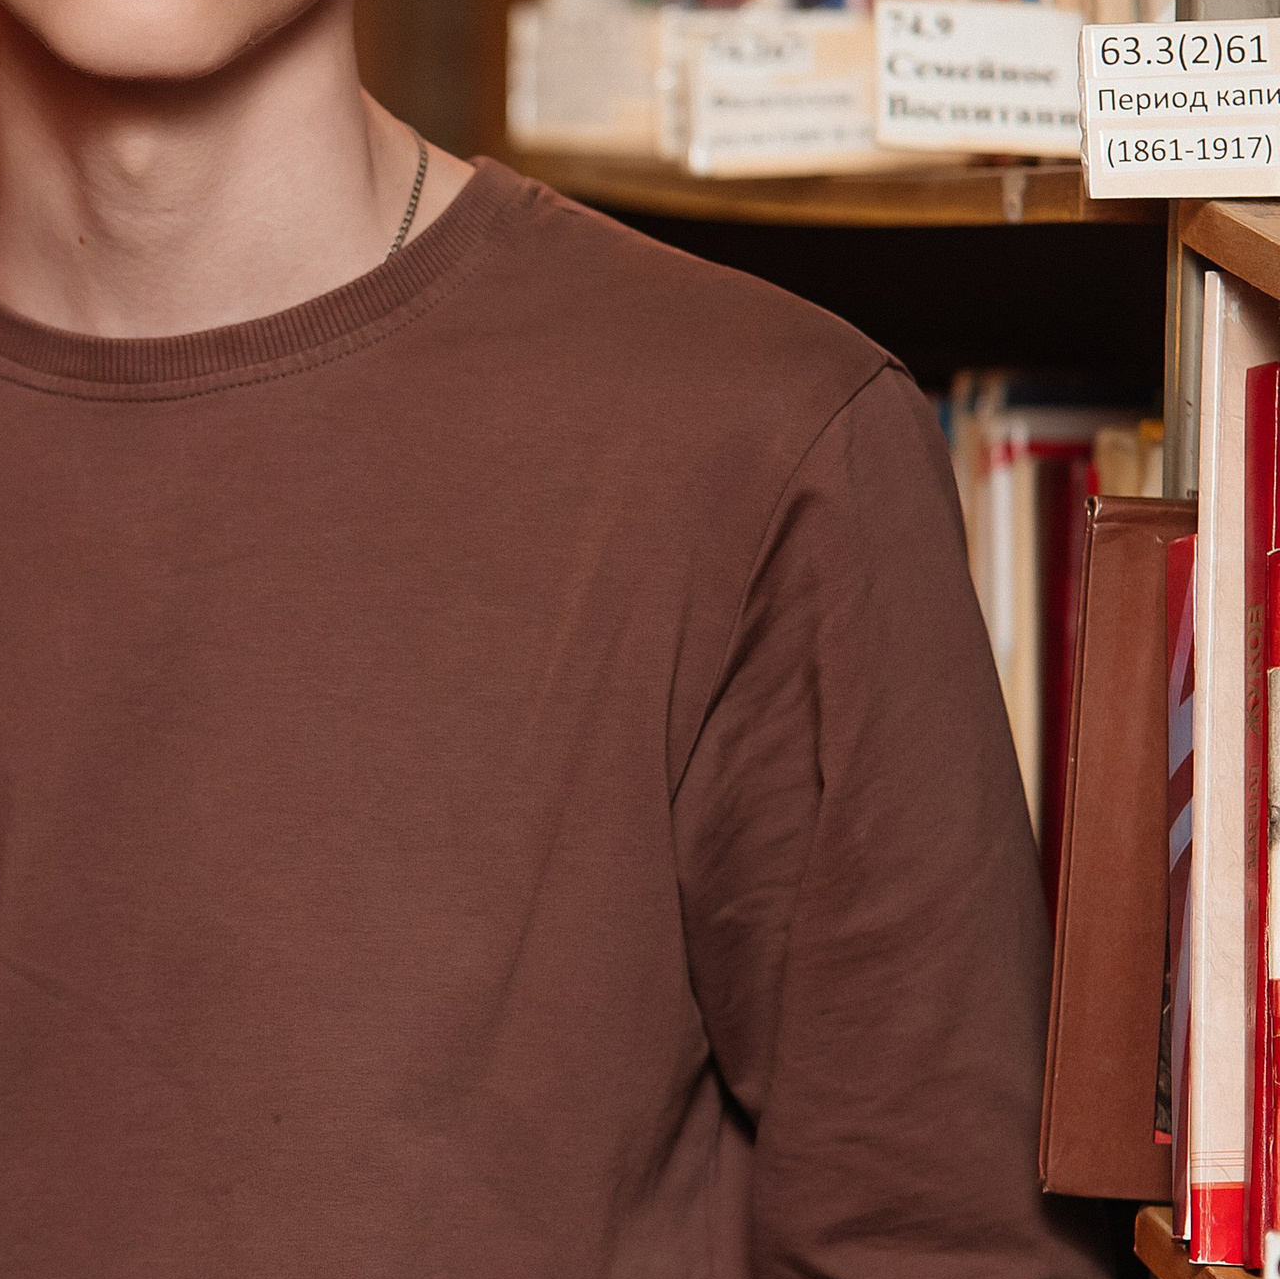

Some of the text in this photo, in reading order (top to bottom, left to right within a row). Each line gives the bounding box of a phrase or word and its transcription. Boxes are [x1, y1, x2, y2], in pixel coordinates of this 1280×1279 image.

[1101, 33, 1268, 71] 63.3(2)61
[1098, 87, 1280, 116] Период капи
[1107, 134, 1272, 169] (1861-1917)
[1246, 605, 1262, 735] ЖУКОВ
